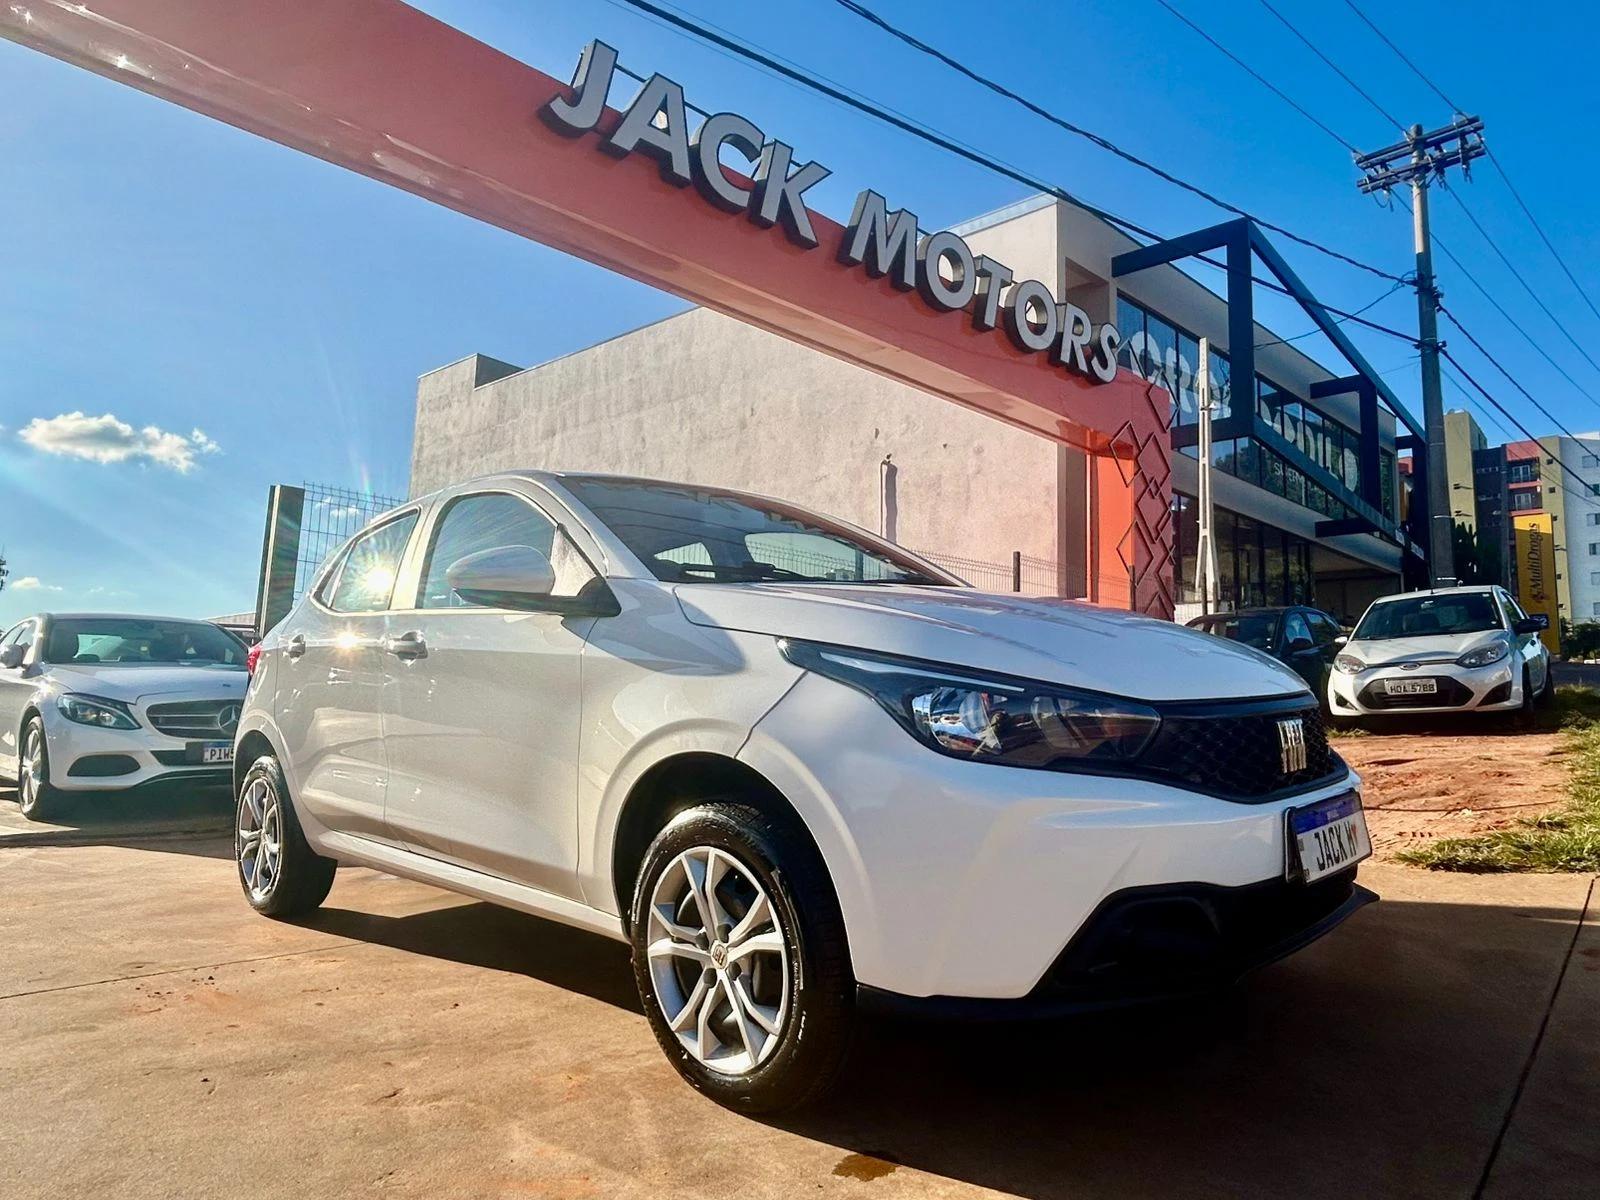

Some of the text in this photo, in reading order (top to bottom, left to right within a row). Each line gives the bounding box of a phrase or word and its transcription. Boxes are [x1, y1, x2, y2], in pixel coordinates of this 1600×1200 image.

[548, 38, 1119, 384] JACK MOTORS
[1525, 522, 1544, 590] MultiDrogas
[1314, 825, 1348, 872] JACK
